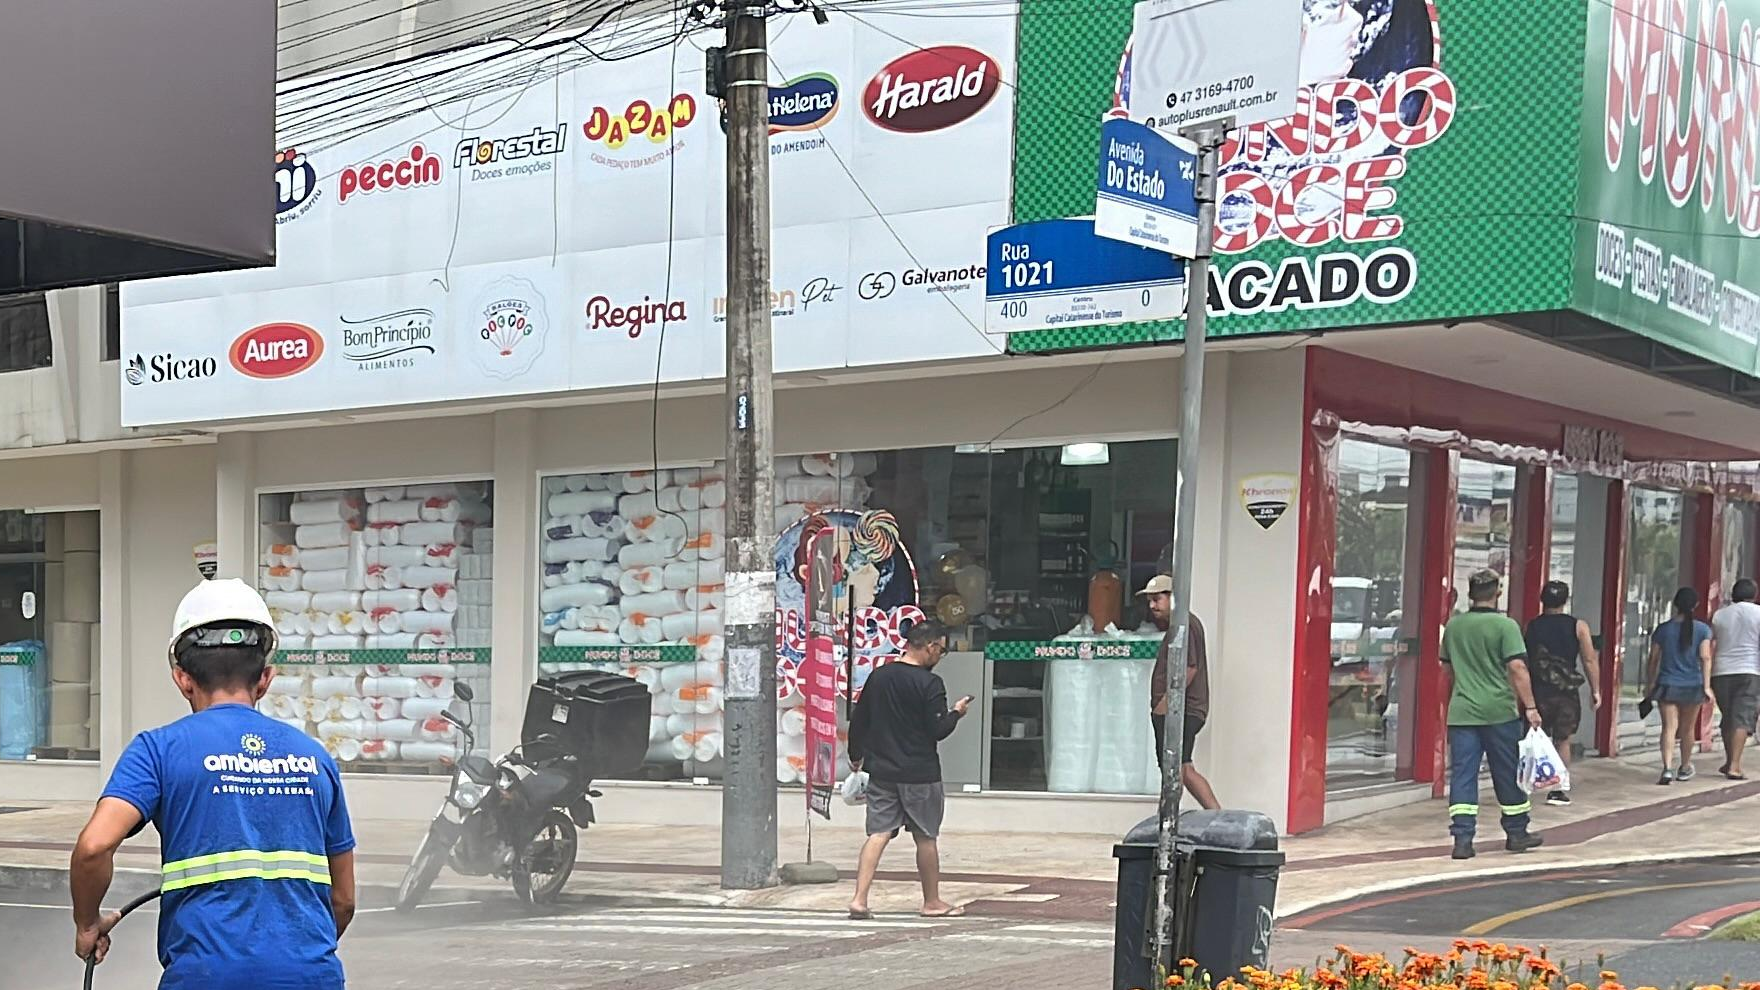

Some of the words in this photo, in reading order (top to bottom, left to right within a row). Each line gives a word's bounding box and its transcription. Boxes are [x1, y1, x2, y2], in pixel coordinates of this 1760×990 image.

[772, 92, 833, 116] Helena
[871, 61, 987, 118] Harald
[1180, 91, 1193, 104] 47
[1195, 75, 1254, 101] 3169-4700
[585, 95, 694, 147] JAZAM
[1158, 90, 1278, 127] autoplusrenault.com.br
[453, 122, 568, 169] Florestal
[784, 137, 826, 153] AMENDOIM
[1108, 137, 1145, 166] Avenida
[338, 145, 440, 202] peccin
[471, 167, 503, 182] Doces
[506, 161, 552, 179] emoções
[1106, 160, 1124, 189] Do
[1126, 165, 1166, 201] Estado
[1001, 242, 1030, 262] Rua
[902, 264, 987, 286] Galvanote
[1001, 260, 1053, 288] 1021
[586, 295, 688, 338] Regina
[1000, 300, 1028, 319] 400
[1142, 288, 1151, 307] 0
[243, 337, 309, 364] Aurea
[357, 358, 415, 371] ALIMENTOS
[150, 354, 217, 383] Sicao
[203, 752, 319, 775] ambiental
